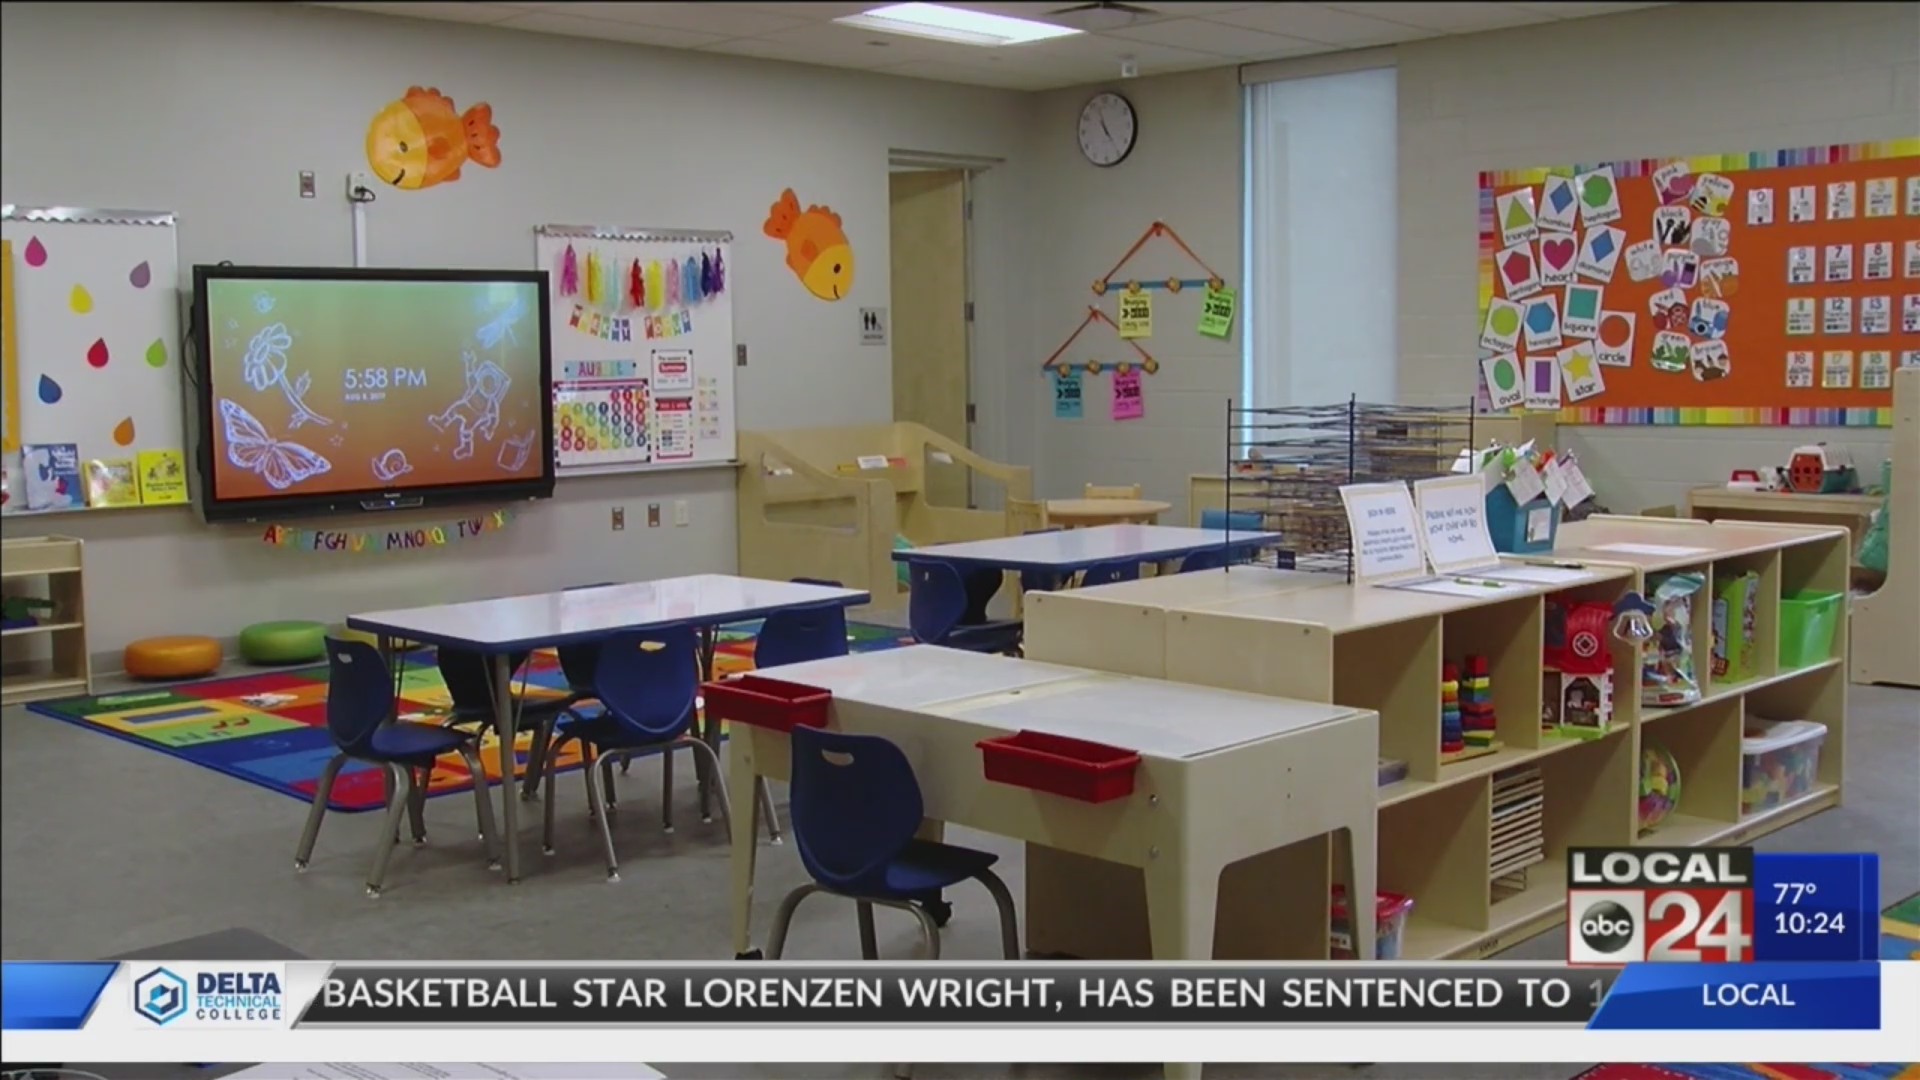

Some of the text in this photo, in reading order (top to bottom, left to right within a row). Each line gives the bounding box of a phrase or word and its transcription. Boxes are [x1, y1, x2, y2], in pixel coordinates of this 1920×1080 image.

[1702, 175, 1730, 189] yellow
[1836, 183, 1847, 196] 2
[1757, 190, 1767, 203] 0
[1661, 209, 1684, 218] black
[1504, 228, 1537, 242] triangle
[1835, 245, 1844, 258] 7
[1873, 243, 1883, 256] 8
[1543, 270, 1574, 283] heart
[1658, 291, 1675, 301] red
[1832, 298, 1845, 311] 12
[1869, 297, 1883, 310] 13
[1563, 322, 1597, 333] square
[1598, 352, 1627, 363] circle
[1793, 352, 1806, 365] 16
[344, 367, 428, 389] 5:58 PM
[1574, 382, 1596, 398] star
[1498, 390, 1521, 405] oval
